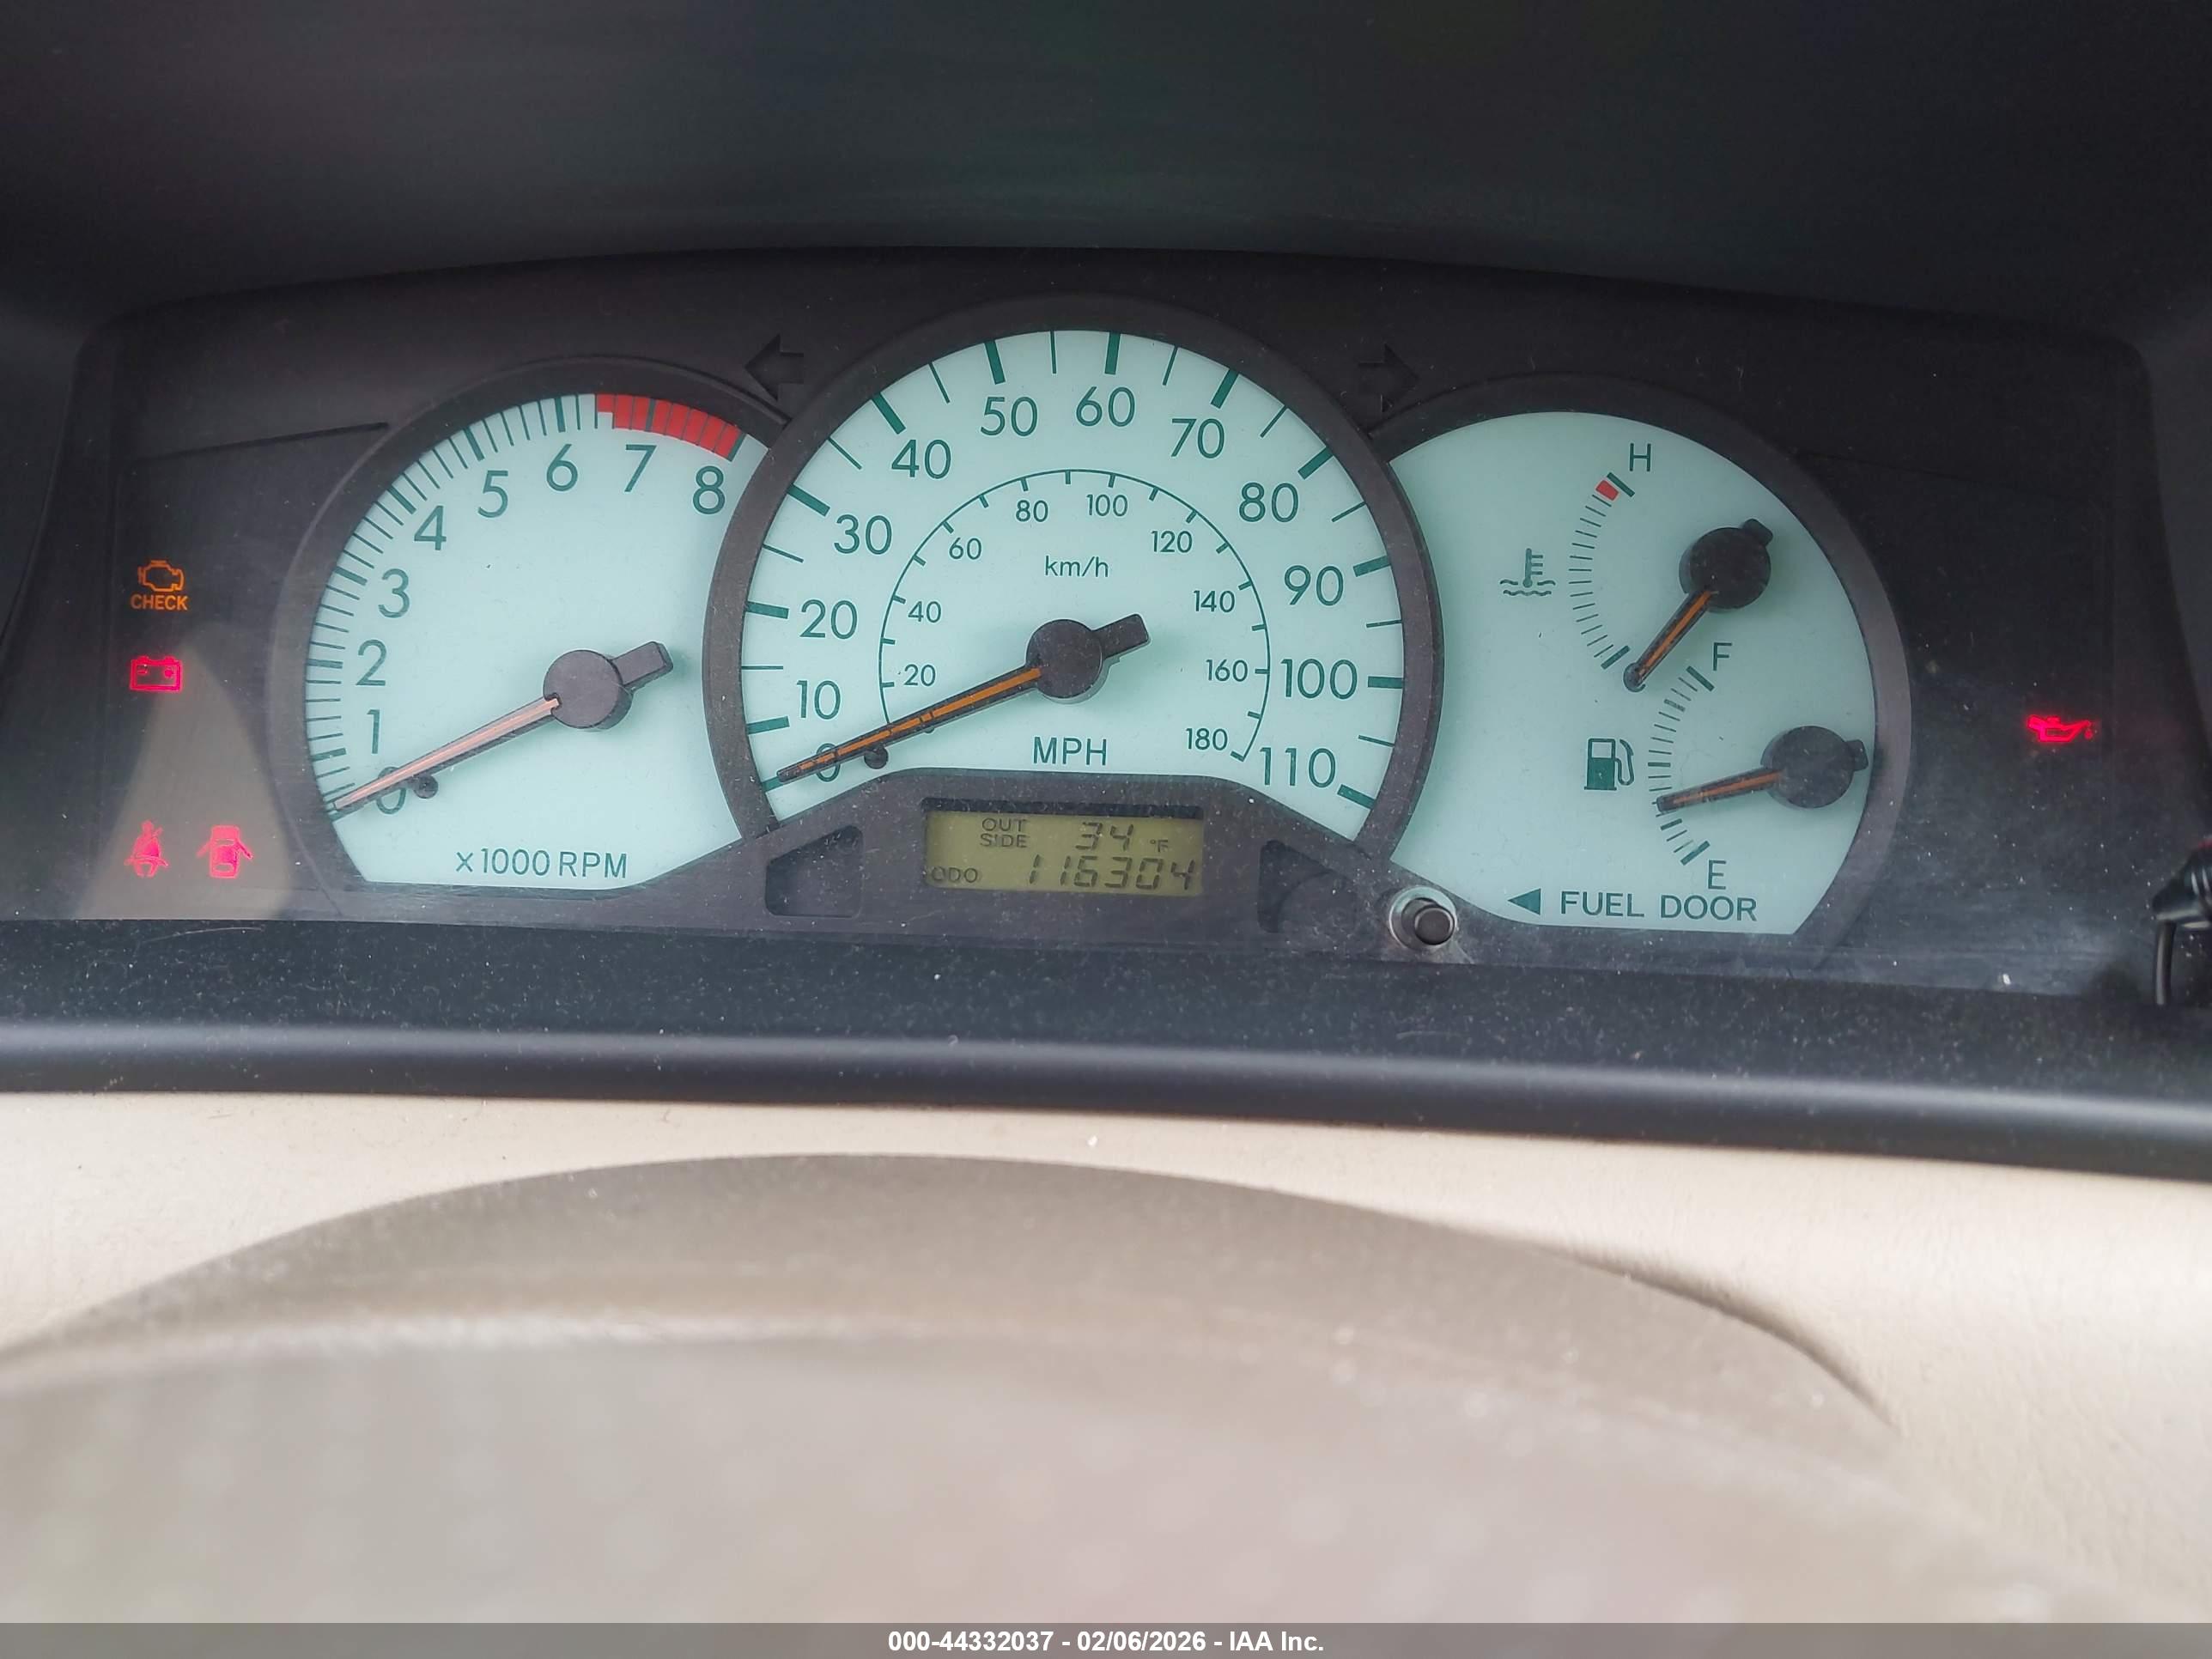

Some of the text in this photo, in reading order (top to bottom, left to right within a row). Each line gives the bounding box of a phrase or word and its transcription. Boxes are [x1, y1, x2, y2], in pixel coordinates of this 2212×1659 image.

[981, 397, 1037, 435] 50
[1077, 387, 1135, 426] 60
[1171, 418, 1224, 459] 70
[546, 444, 577, 491] 6
[626, 445, 657, 492] 7
[892, 440, 951, 479] 40
[1631, 443, 1651, 471] H
[478, 471, 508, 518] 5
[693, 466, 726, 514] 8
[1087, 495, 1127, 517] 100
[1240, 483, 1298, 522] 80
[1016, 500, 1048, 522] 80
[415, 506, 447, 550] 4
[834, 515, 891, 554] 30
[1151, 531, 1192, 553] 120
[950, 538, 981, 560] 60
[1044, 555, 1109, 578] km/h
[131, 593, 187, 611] CHECK
[378, 568, 410, 617] 3
[1194, 591, 1235, 612] 140
[1285, 566, 1343, 605] 90
[800, 599, 857, 639] 20
[908, 601, 941, 623] 40
[356, 640, 386, 686] 2
[1206, 659, 1248, 682] 160
[1713, 642, 1732, 671] F
[904, 665, 935, 686] 20
[1282, 659, 1357, 699] 100
[797, 680, 841, 719] 10
[367, 709, 379, 754] 1
[1186, 728, 1228, 750] 180
[1033, 737, 1107, 765] MPH
[1261, 747, 1336, 787] 110
[980, 833, 1028, 849] SIDE
[981, 817, 1029, 833] OUT
[1075, 822, 1133, 850] 34
[559, 851, 627, 878] RPM
[931, 854, 1194, 890] ODO 116304
[1708, 860, 1727, 890] E
[1560, 891, 1757, 921] FUEL DOOR
